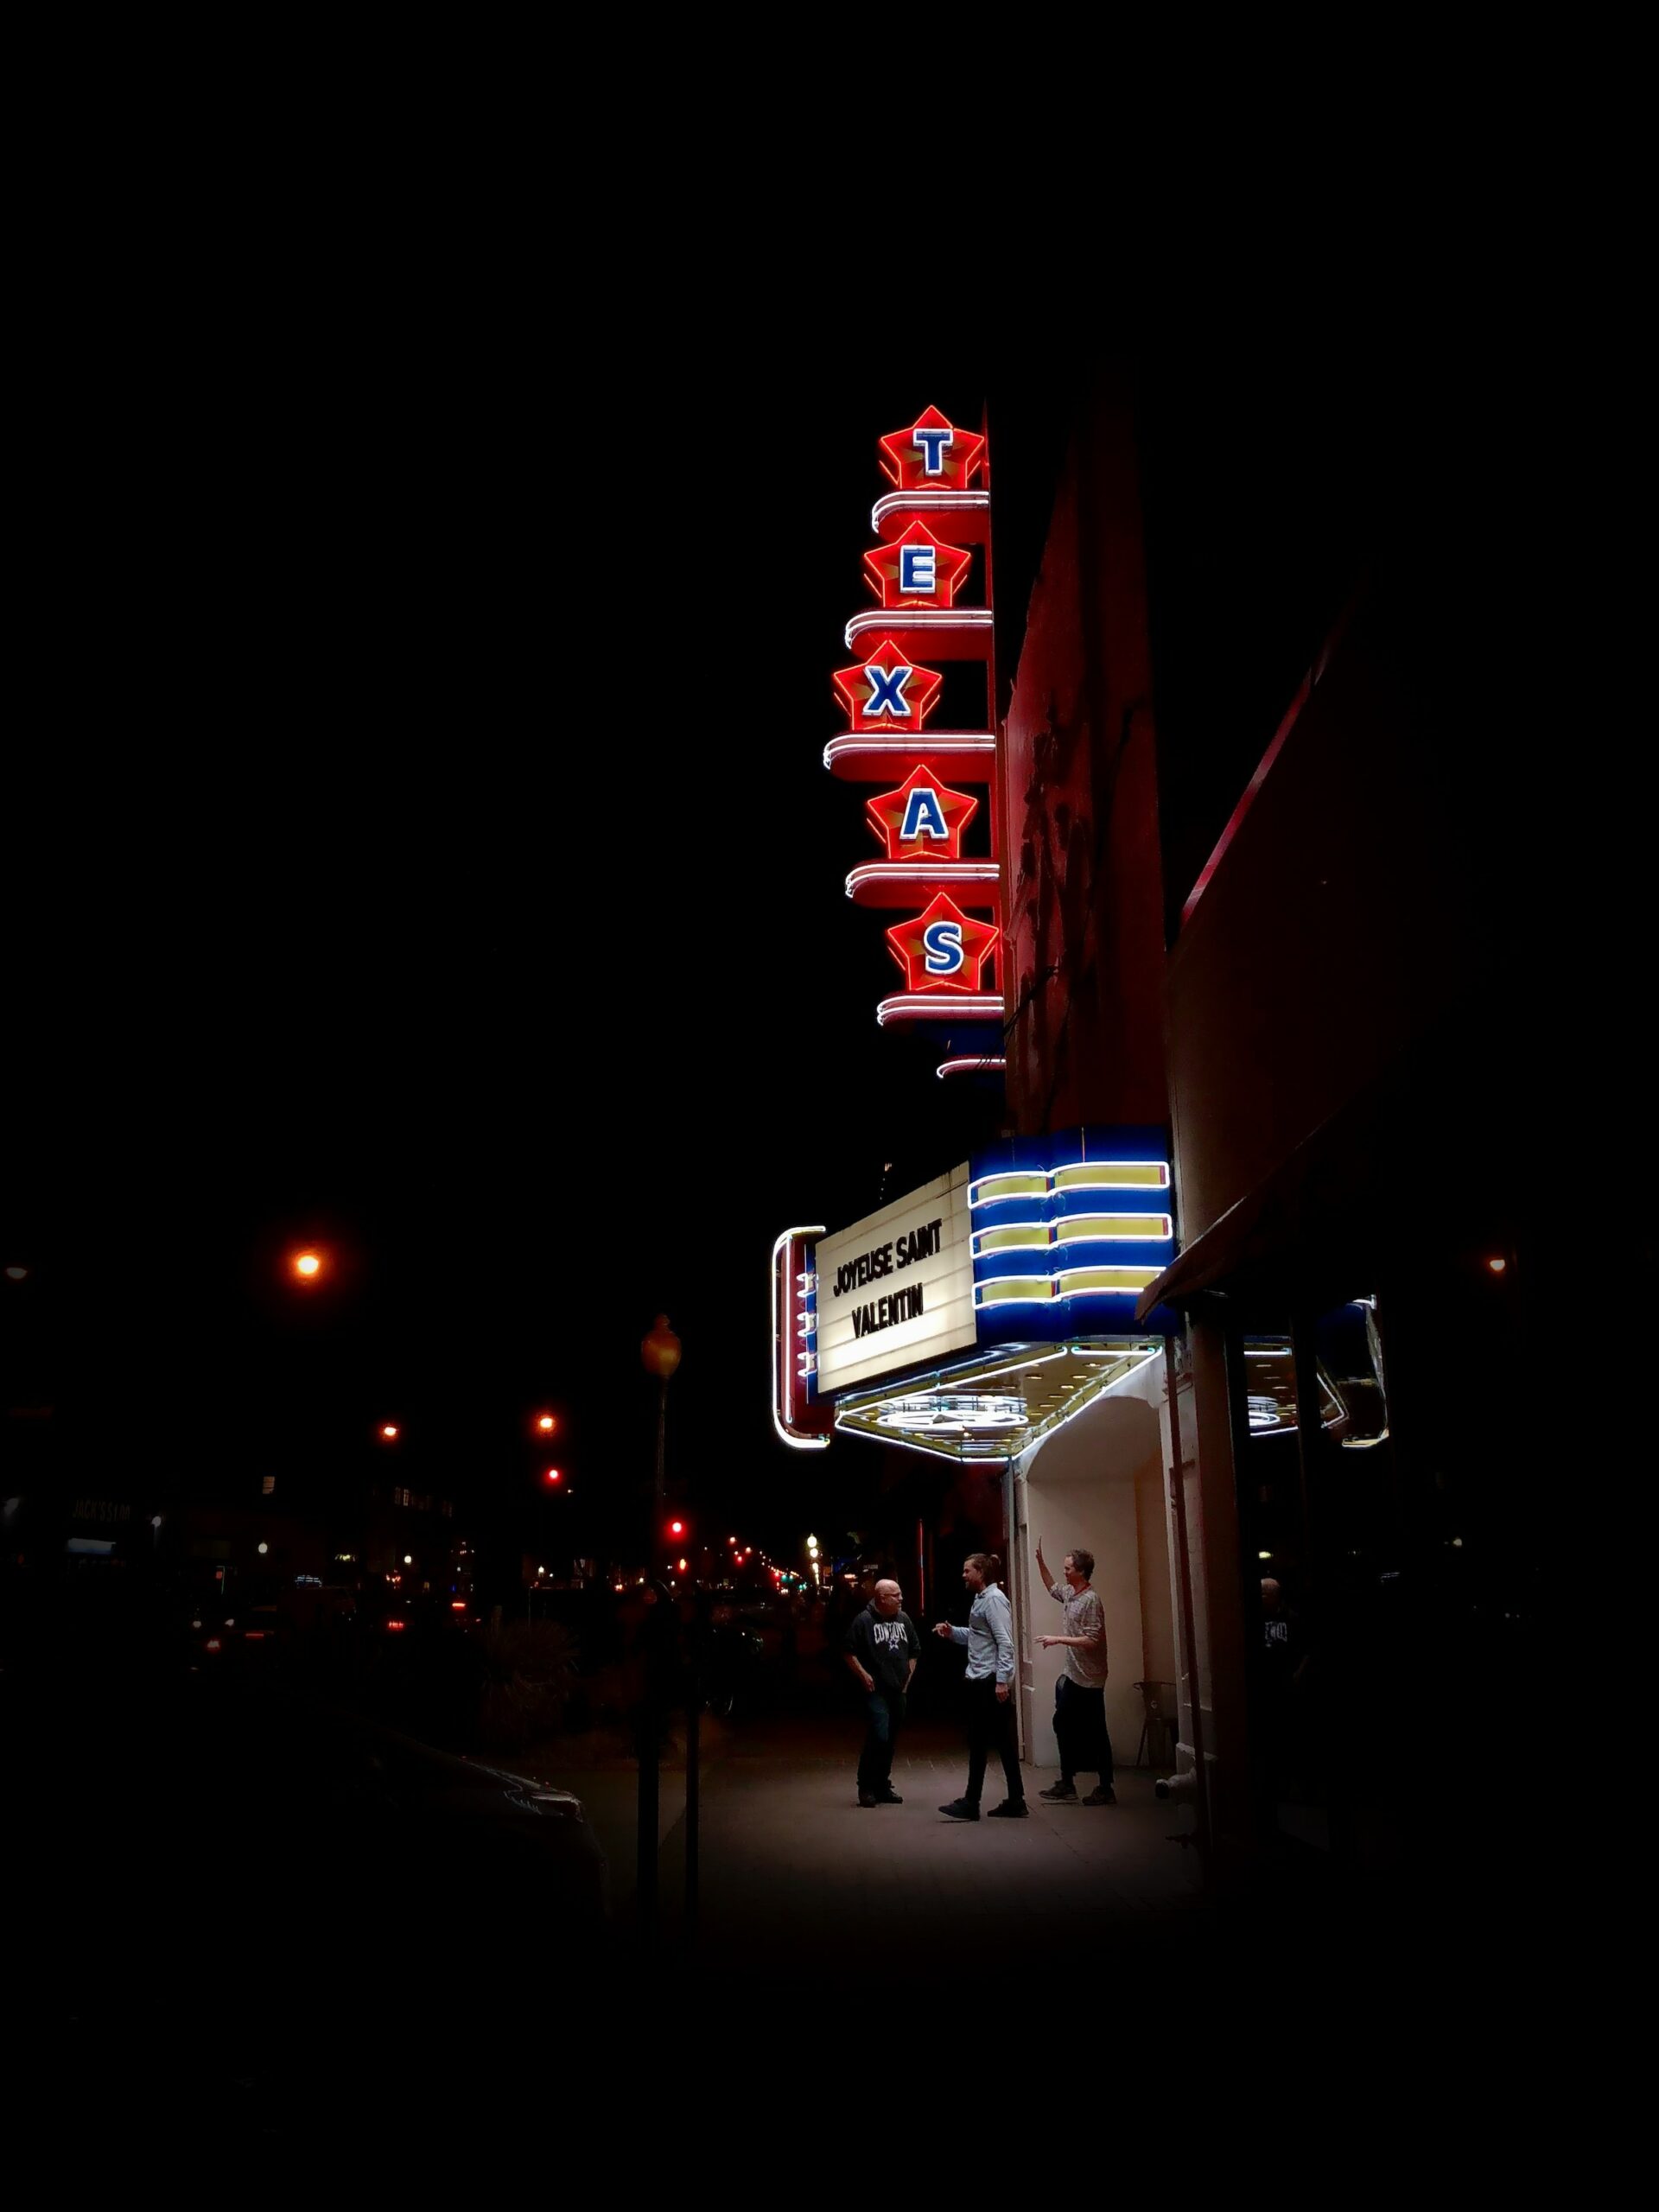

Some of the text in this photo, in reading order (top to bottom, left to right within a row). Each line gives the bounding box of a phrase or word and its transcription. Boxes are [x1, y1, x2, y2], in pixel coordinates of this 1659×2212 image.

[862, 429, 963, 975] TEXAS
[833, 1217, 943, 1297] JOYEUSE SAINT
[851, 1282, 924, 1339] VALENTIN
